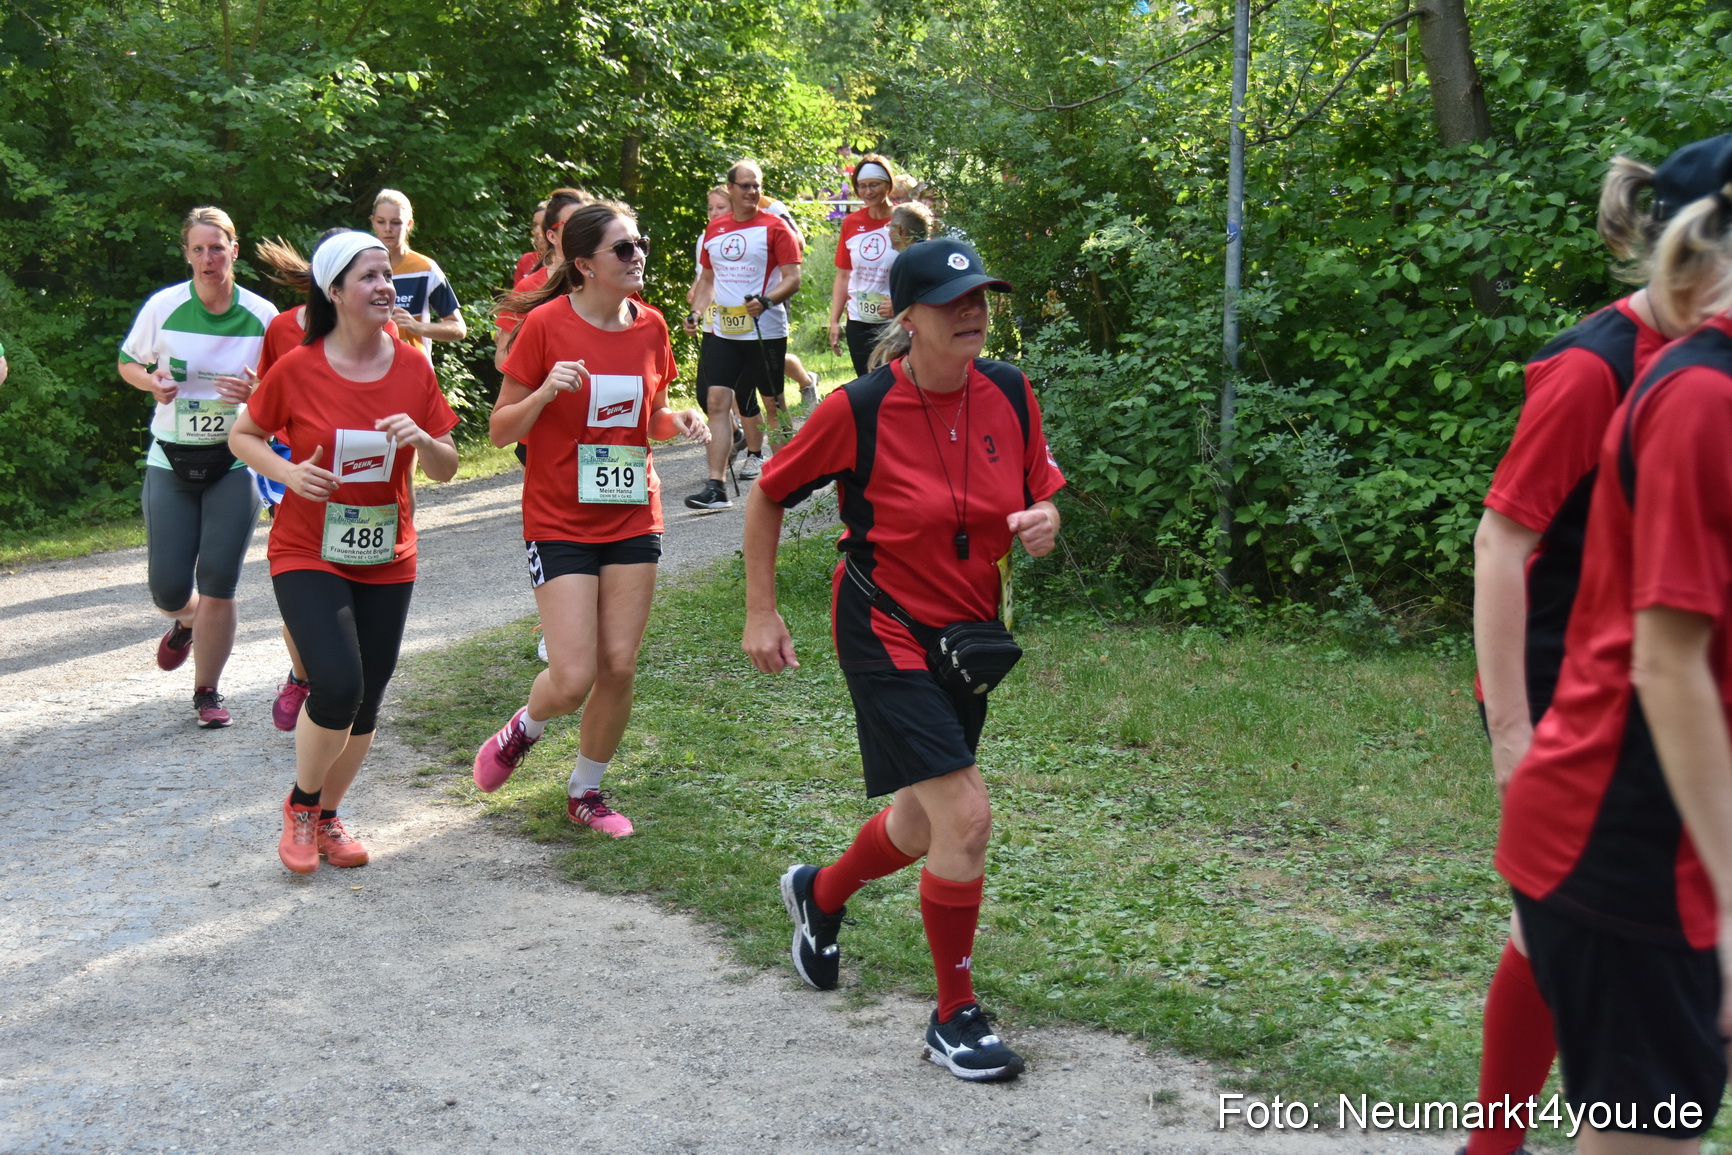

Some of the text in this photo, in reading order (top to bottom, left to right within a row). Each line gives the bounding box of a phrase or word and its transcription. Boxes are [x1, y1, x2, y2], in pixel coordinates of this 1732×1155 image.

[722, 315, 746, 327] 1907
[189, 415, 225, 432] 122
[983, 435, 996, 454] 3
[352, 460, 373, 470] DEHN
[595, 466, 635, 488] 519
[340, 527, 384, 549] 488
[330, 546, 372, 556] Frauenknecht
